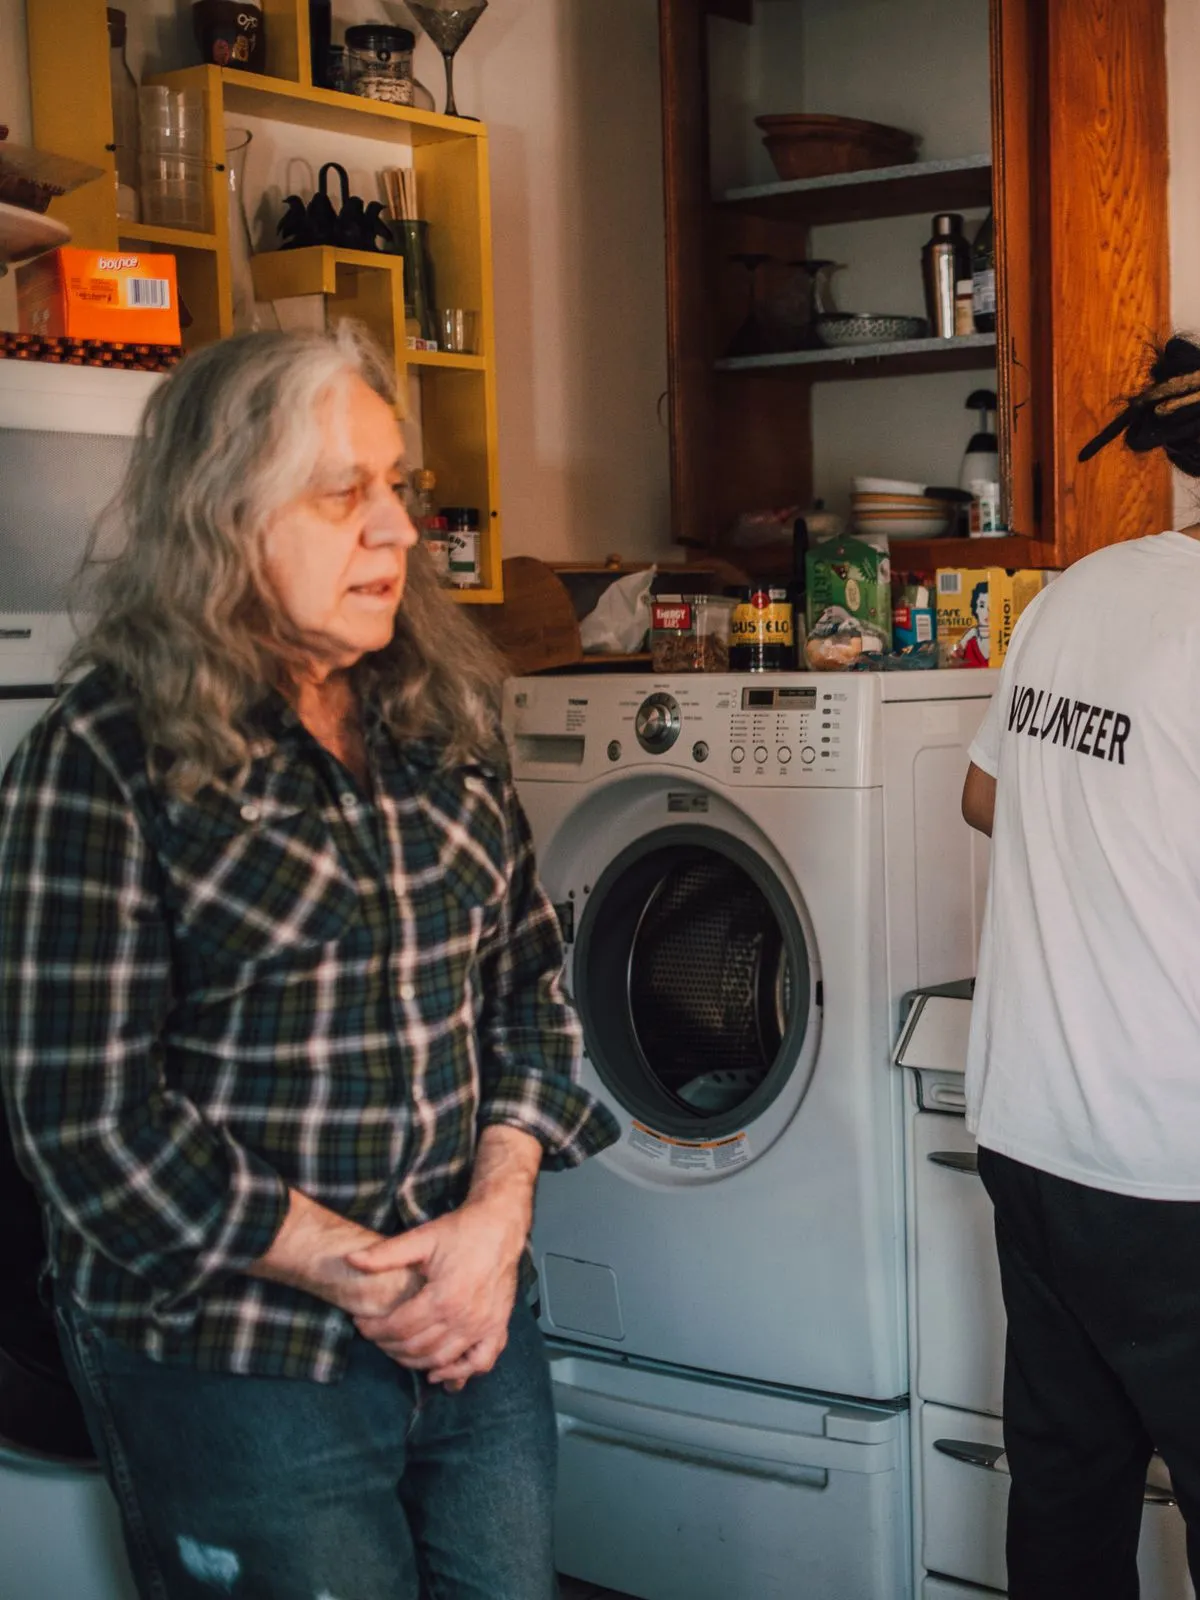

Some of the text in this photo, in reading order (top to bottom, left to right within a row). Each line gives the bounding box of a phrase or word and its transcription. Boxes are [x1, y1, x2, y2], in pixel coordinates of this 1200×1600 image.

[98, 257, 138, 270] bounce
[732, 620, 789, 633] BUSELO
[1007, 685, 1131, 765] VOLUNTEER
